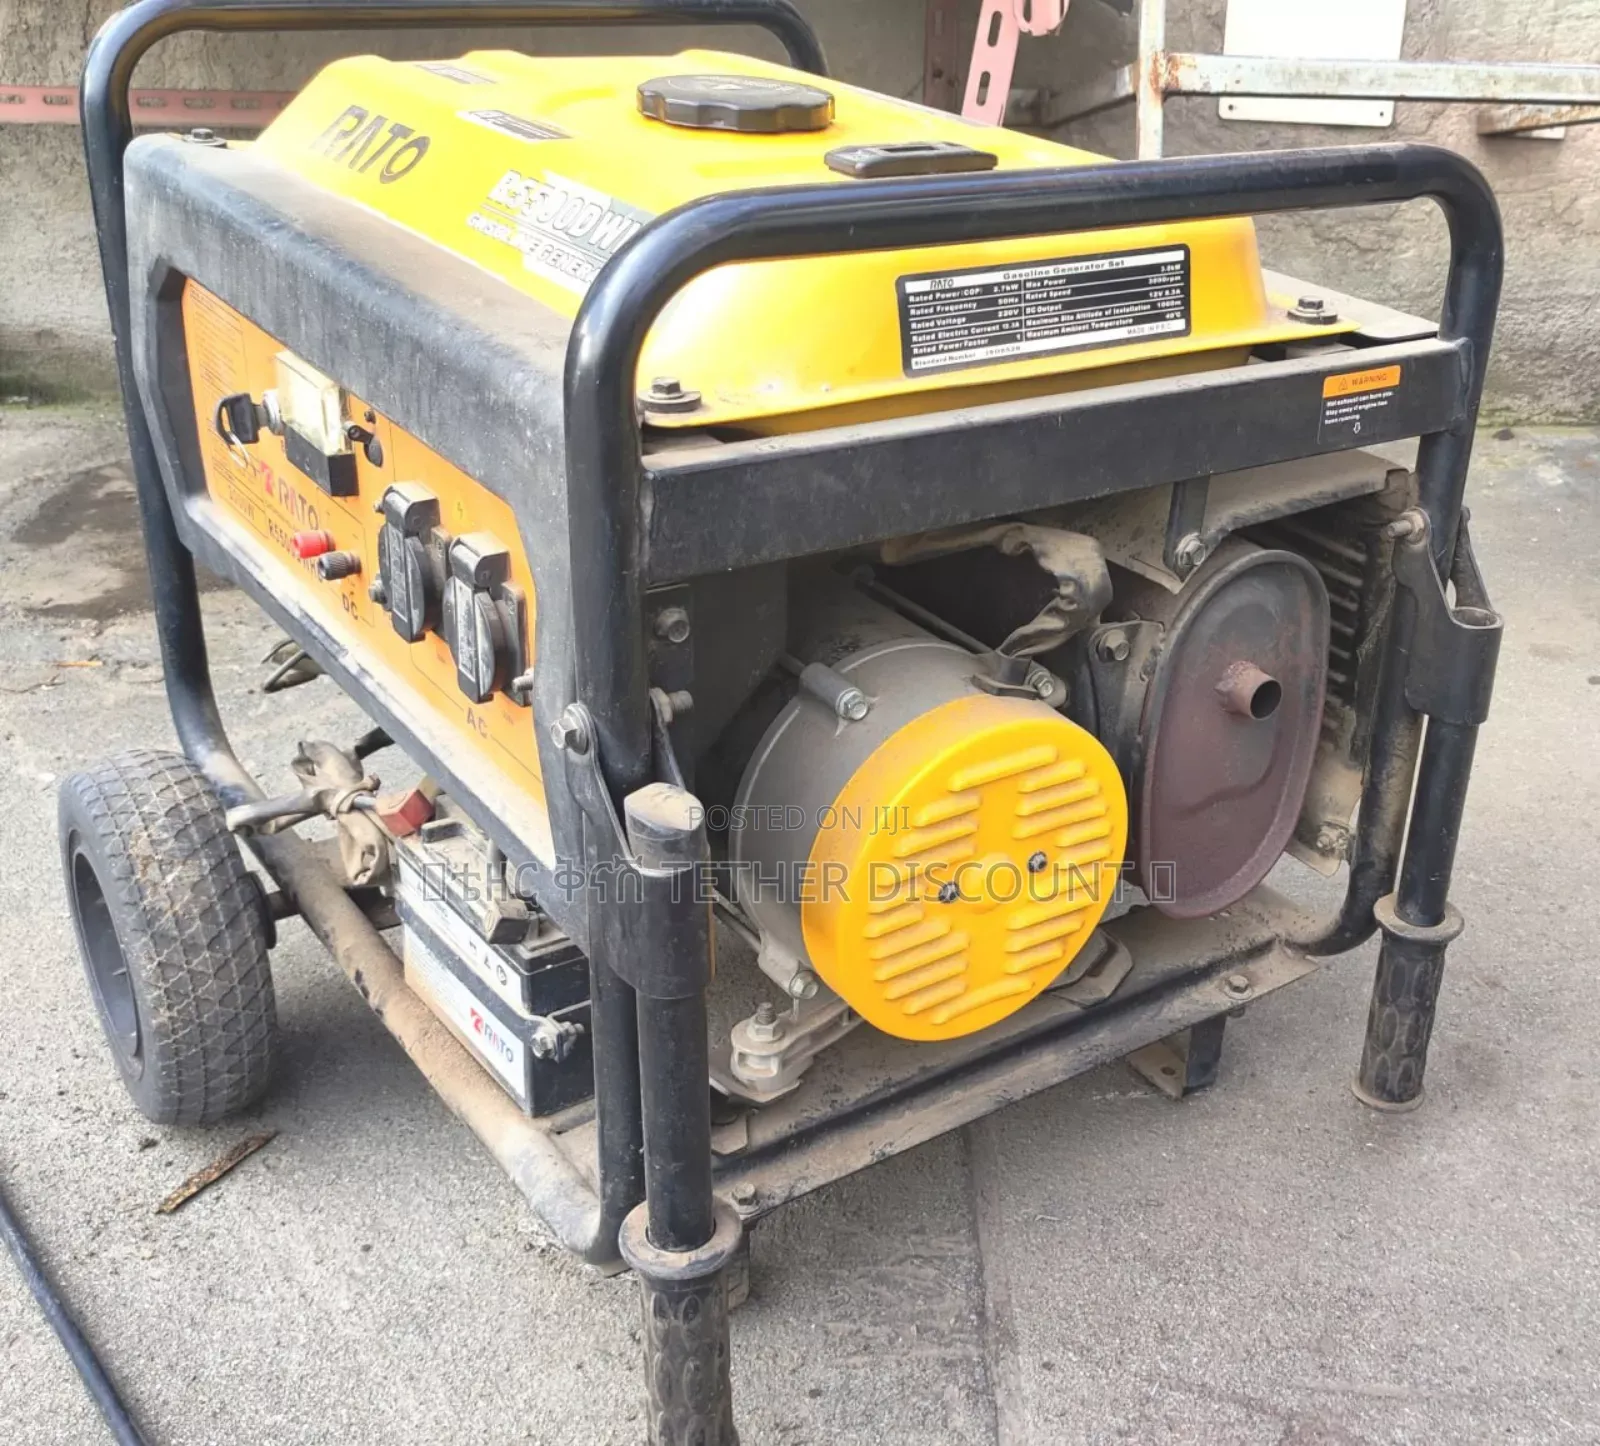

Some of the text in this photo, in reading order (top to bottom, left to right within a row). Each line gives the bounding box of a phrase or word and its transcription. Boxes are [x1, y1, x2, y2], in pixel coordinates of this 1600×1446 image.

[309, 104, 431, 184] RATO
[1003, 259, 1125, 280] Gasoline Generator Set
[930, 279, 954, 290] RATO
[1025, 278, 1067, 289] Max Power
[908, 294, 934, 302] Rated
[1025, 288, 1072, 300] Rated Speed
[909, 302, 977, 315] Rated Frequency
[1025, 303, 1063, 315] DC Output
[910, 317, 967, 330] Rated Voltage
[1025, 316, 1059, 326] Maximum
[911, 324, 1000, 342] Rated Electric Current
[1026, 318, 1134, 338] Maximum Ambient Temperature
[913, 338, 989, 354] Rated Power Factor
[914, 356, 947, 366] Standard
[1352, 374, 1386, 386] WARNING
[278, 477, 318, 531] RATO
[342, 591, 359, 620] DC
[466, 707, 488, 738] AC
